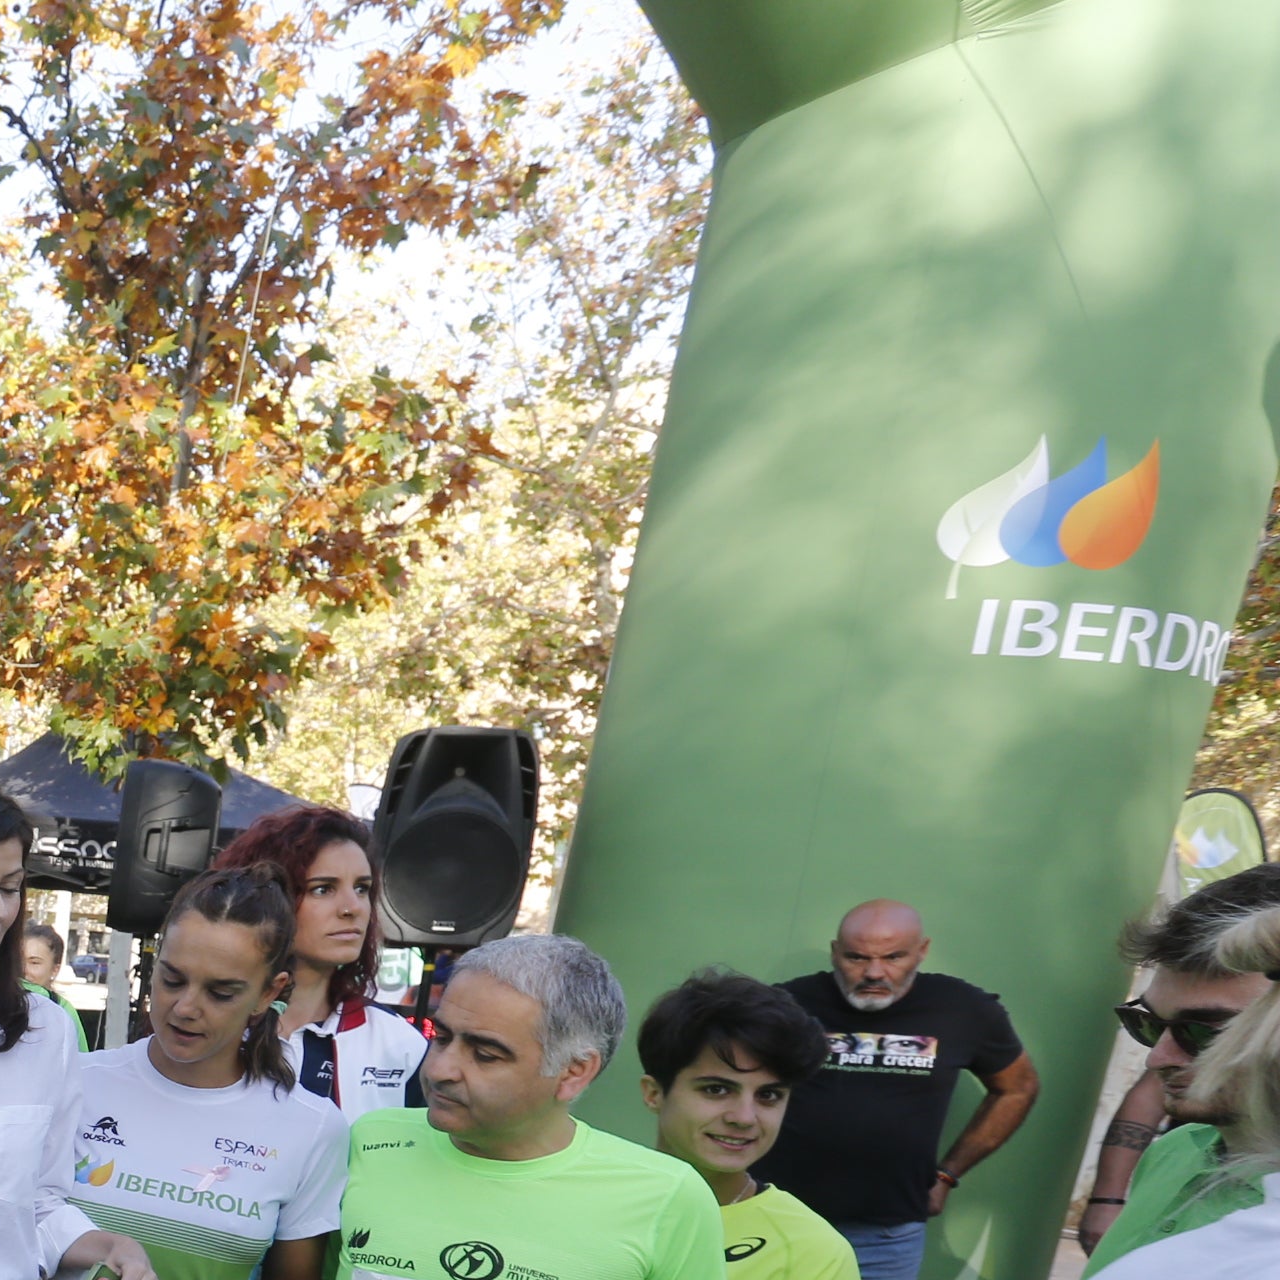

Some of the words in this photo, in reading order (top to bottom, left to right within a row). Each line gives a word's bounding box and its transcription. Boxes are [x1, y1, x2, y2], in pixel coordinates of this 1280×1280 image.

[839, 1053, 874, 1065] para
[214, 1137, 279, 1160] ESPAÑA
[362, 1140, 401, 1151] luanvi
[116, 1172, 262, 1220] IBERDROLA
